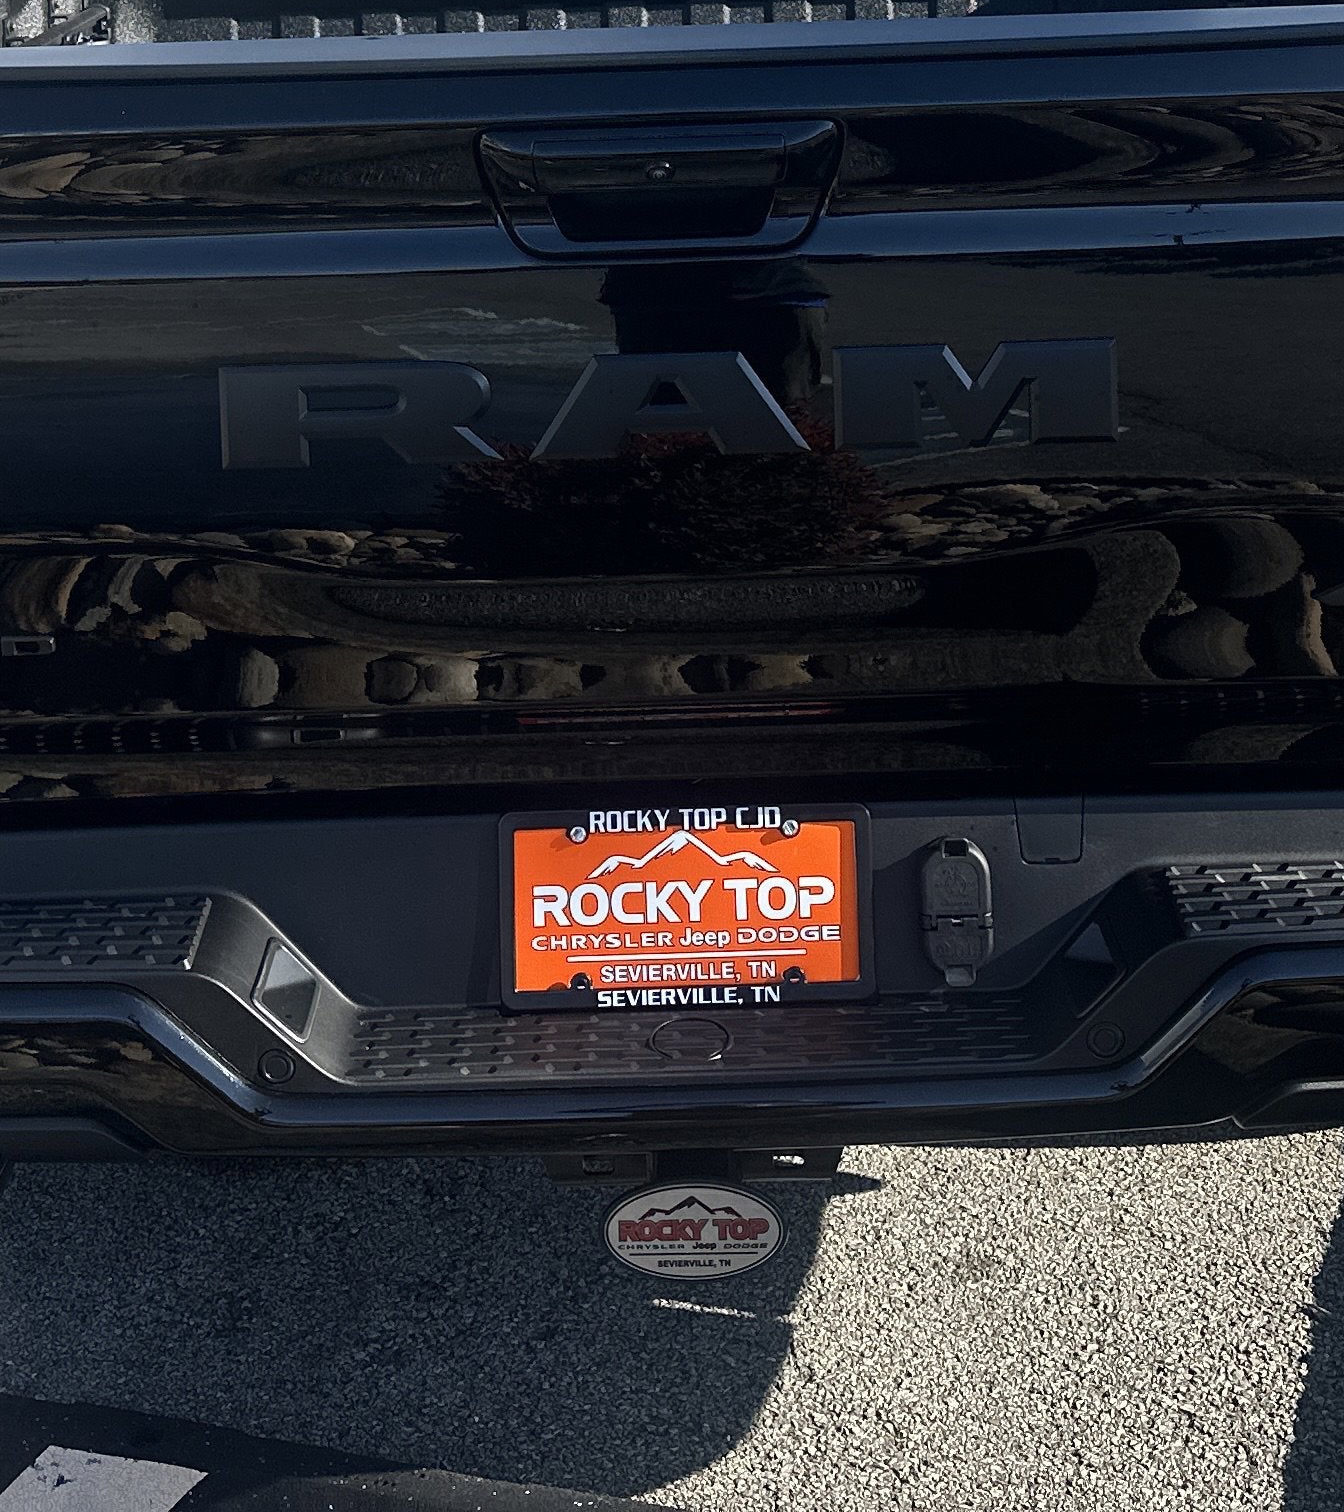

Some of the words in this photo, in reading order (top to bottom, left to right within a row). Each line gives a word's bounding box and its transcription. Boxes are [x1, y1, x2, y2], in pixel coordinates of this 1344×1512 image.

[218, 336, 1120, 471] RAM
[589, 809, 670, 833] ROCKY
[678, 807, 727, 830] TOP
[735, 806, 781, 828] CJD
[532, 878, 715, 928] ROCKY
[723, 875, 837, 921] TOP
[531, 931, 674, 952] CHRYSLER
[678, 927, 731, 949] Jeep
[737, 925, 842, 945] DODGE
[599, 963, 742, 984] SEVIERVILLE,
[747, 960, 777, 979] TN
[597, 987, 744, 1008] SEVIERVILLE,
[751, 986, 782, 1003] TN
[618, 1219, 708, 1242] ROCKY
[712, 1218, 770, 1241] TOP
[692, 1242, 717, 1251] Jeep
[657, 1259, 716, 1268] SEVIERVILLE,
[718, 1259, 732, 1267] TN
